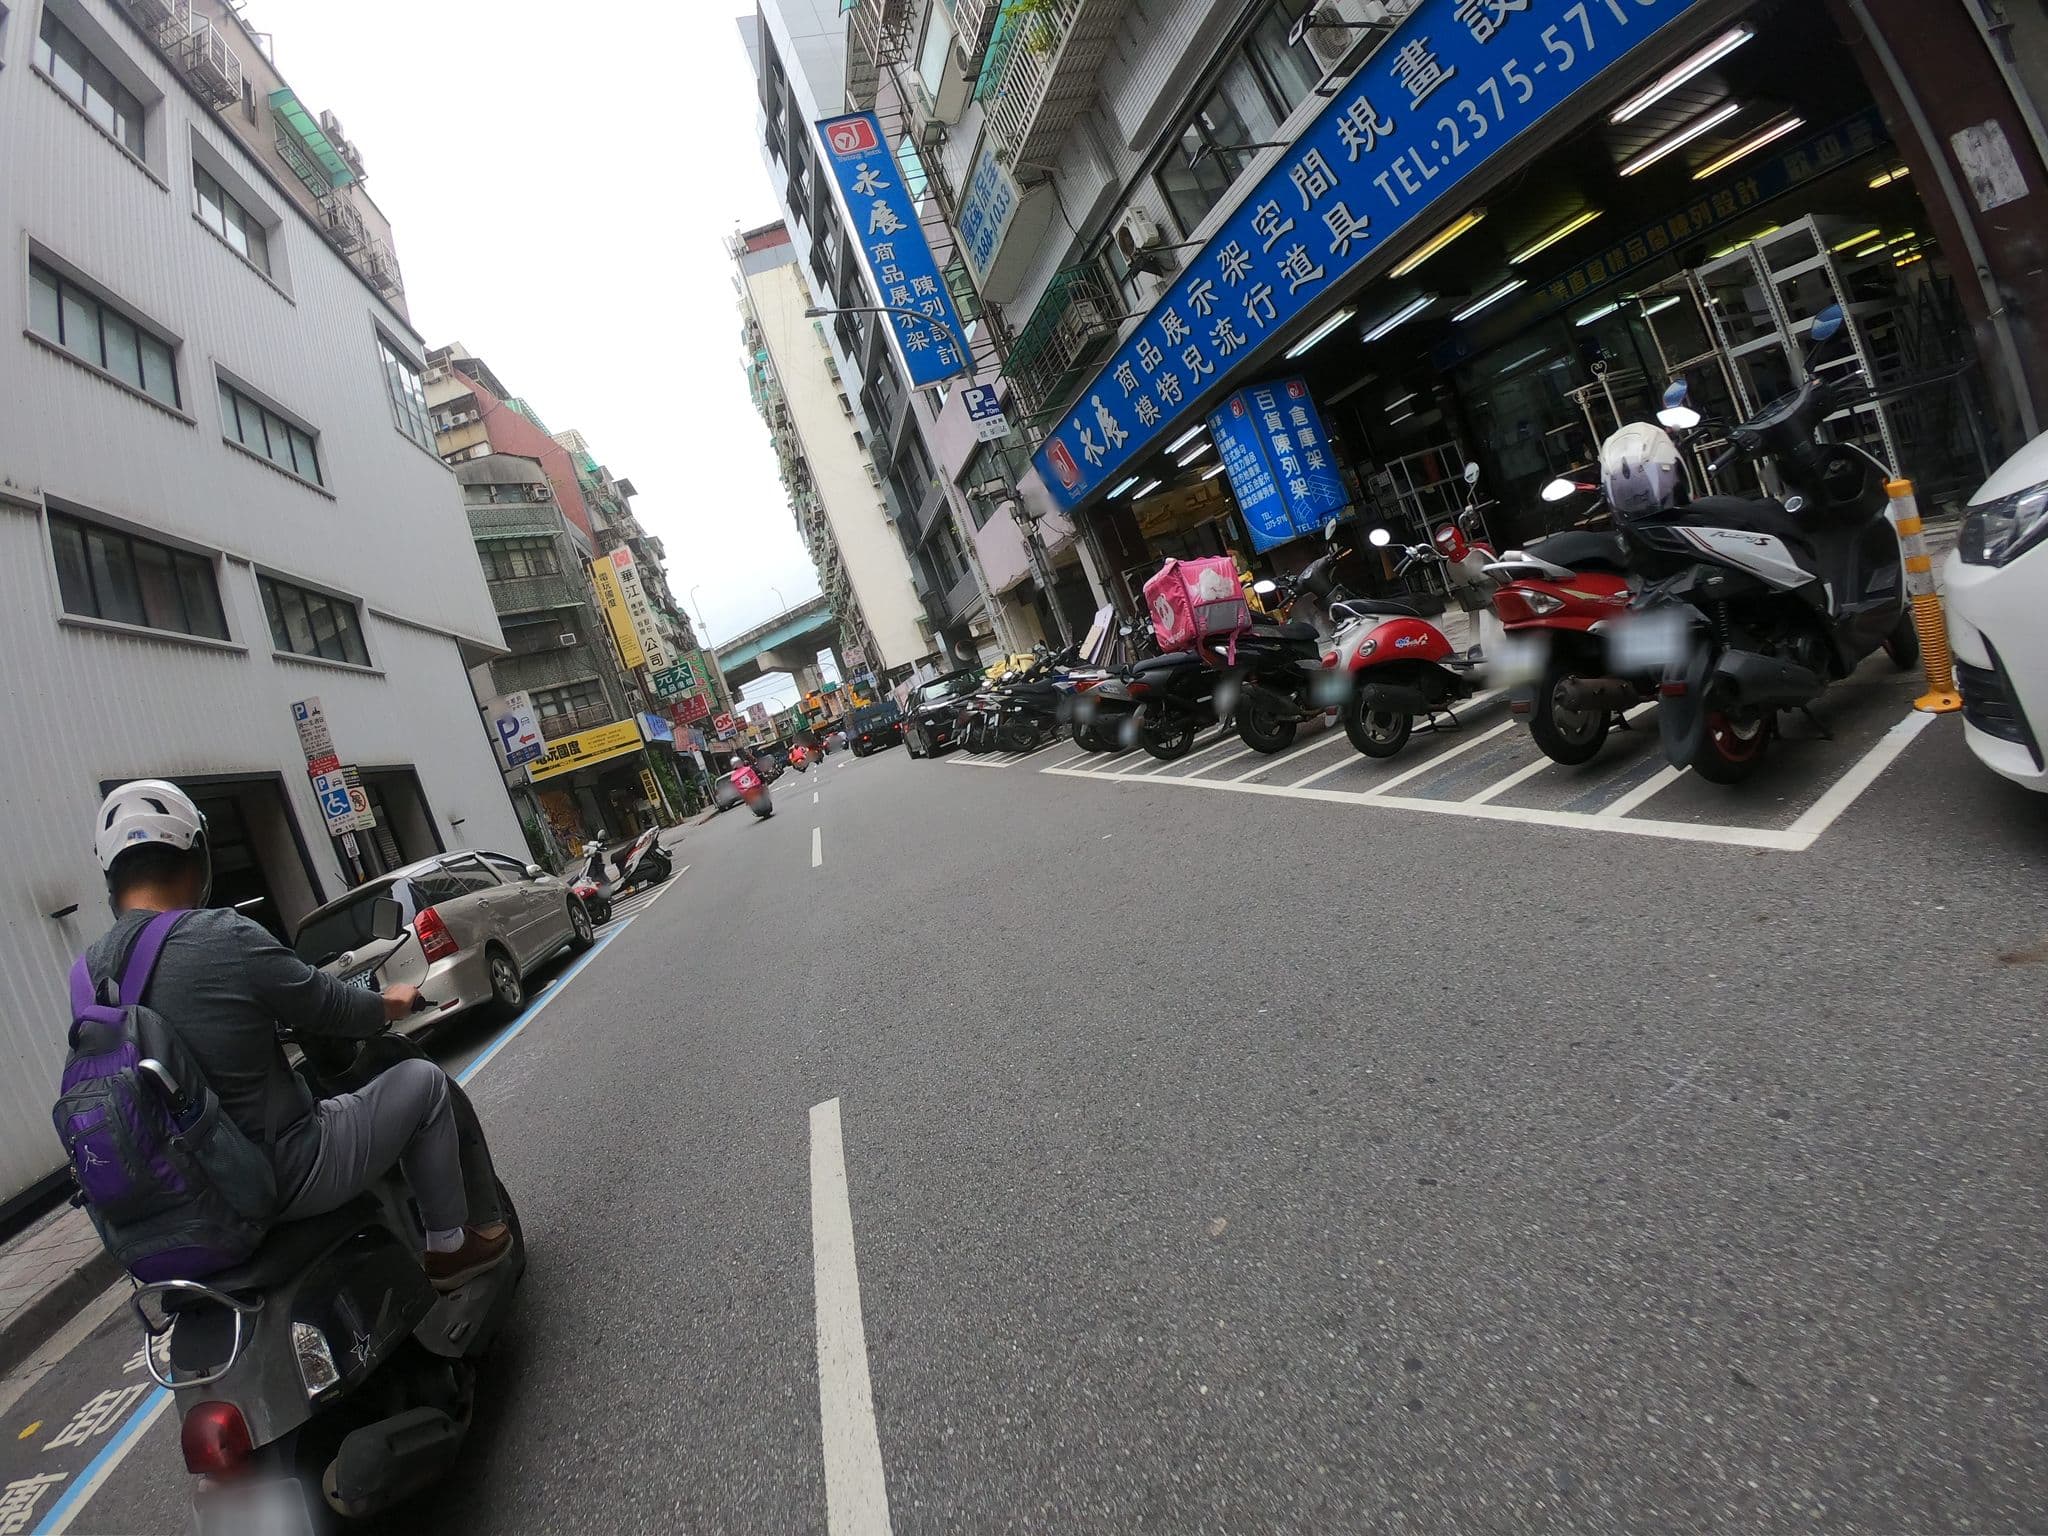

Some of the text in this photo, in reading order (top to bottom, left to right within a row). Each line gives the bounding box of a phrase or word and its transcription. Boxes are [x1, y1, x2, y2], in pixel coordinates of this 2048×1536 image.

[1373, 0, 1655, 207] TEL:2375-571
[974, 183, 1011, 274] 2388-1033
[1134, 201, 1369, 427] 模特兒流行道具
[965, 389, 984, 411] P
[1253, 389, 1312, 500] 百貨陳列架
[1288, 405, 1327, 471] 倉庫架
[620, 569, 640, 599] 華江
[645, 637, 664, 667] 公司
[656, 665, 690, 687] 元太
[295, 703, 306, 719] P
[715, 713, 733, 729] OK
[318, 778, 327, 791] P
